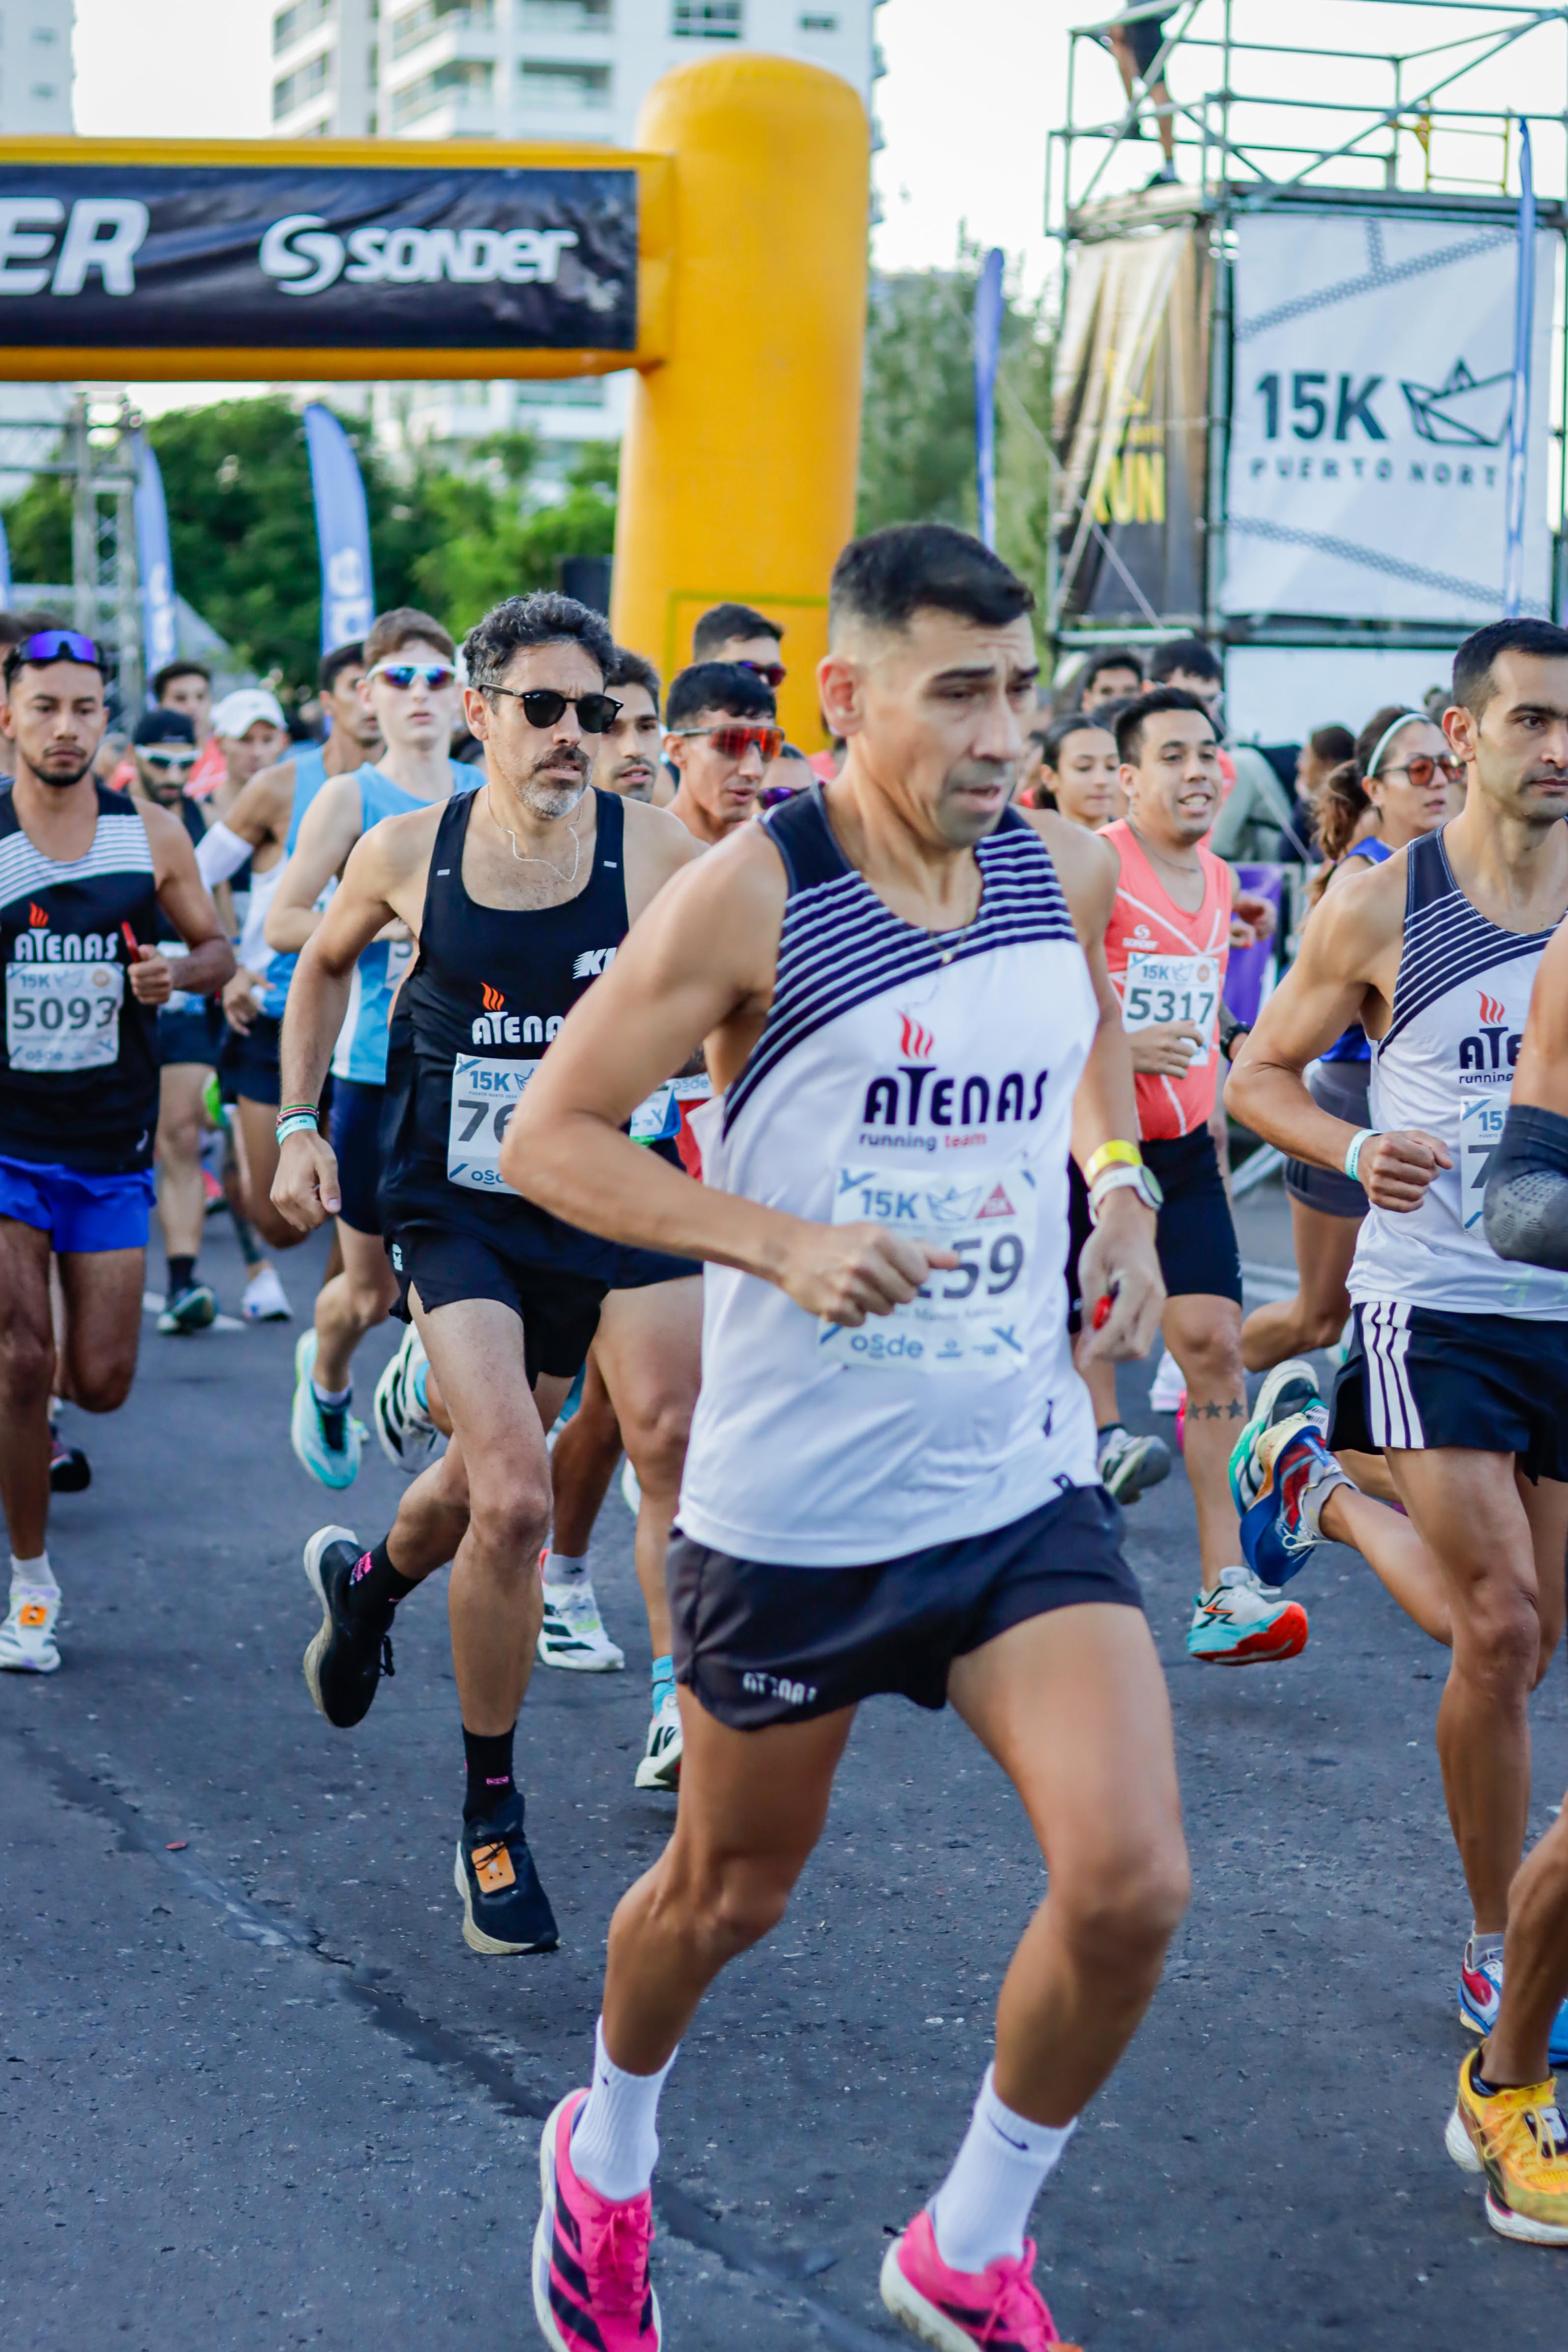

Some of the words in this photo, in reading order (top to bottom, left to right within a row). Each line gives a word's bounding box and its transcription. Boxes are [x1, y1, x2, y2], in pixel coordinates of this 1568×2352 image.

[1257, 372, 1387, 441] 15K
[1251, 457, 1391, 482] PUERTO
[1411, 462, 1497, 487] NORT
[15, 928, 118, 962] ATENAS
[1143, 965, 1169, 980] 15K
[13, 997, 117, 1029] 5093
[1126, 987, 1214, 1024] 5317
[472, 1011, 566, 1044] ATENA
[1459, 1027, 1523, 1070] ATE
[470, 1070, 510, 1091] 15K
[863, 1066, 1048, 1126] ATENAS
[1479, 1111, 1509, 1131] 15
[860, 1132, 936, 1151] running
[945, 1132, 987, 1148] team
[861, 1189, 919, 1219] 15K
[916, 1235, 1024, 1300] 59
[850, 1333, 923, 1358] osde
